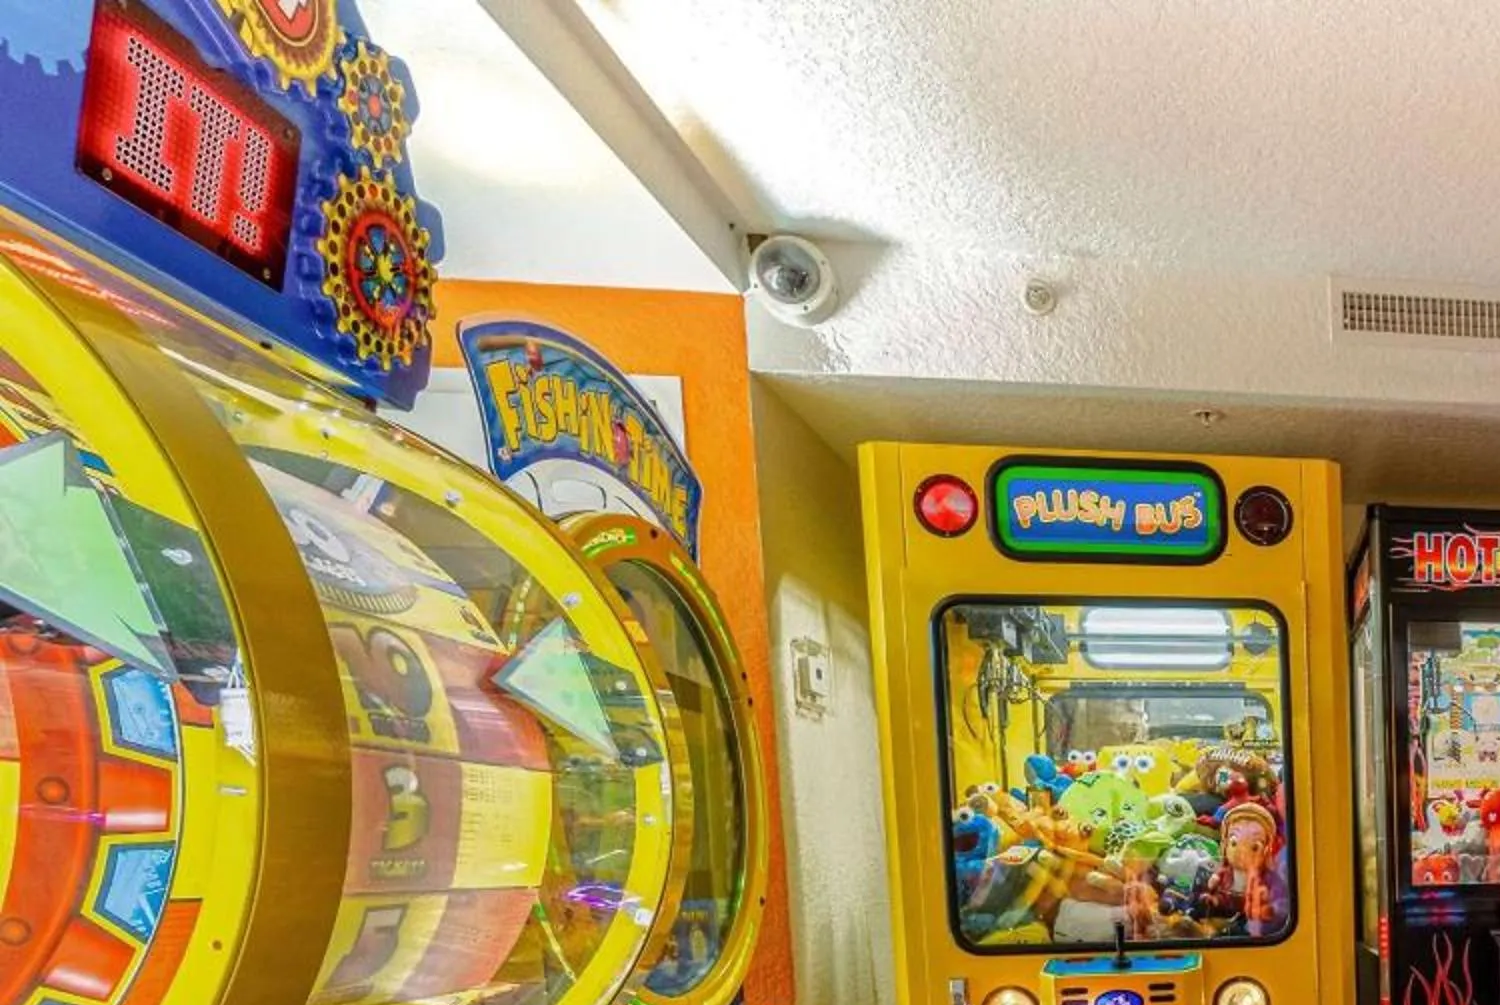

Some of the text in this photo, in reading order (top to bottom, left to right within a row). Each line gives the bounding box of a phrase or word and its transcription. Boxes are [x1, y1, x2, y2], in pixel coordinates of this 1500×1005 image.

[115, 36, 271, 252] IT!
[1013, 488, 1203, 535] PLUSH BUS
